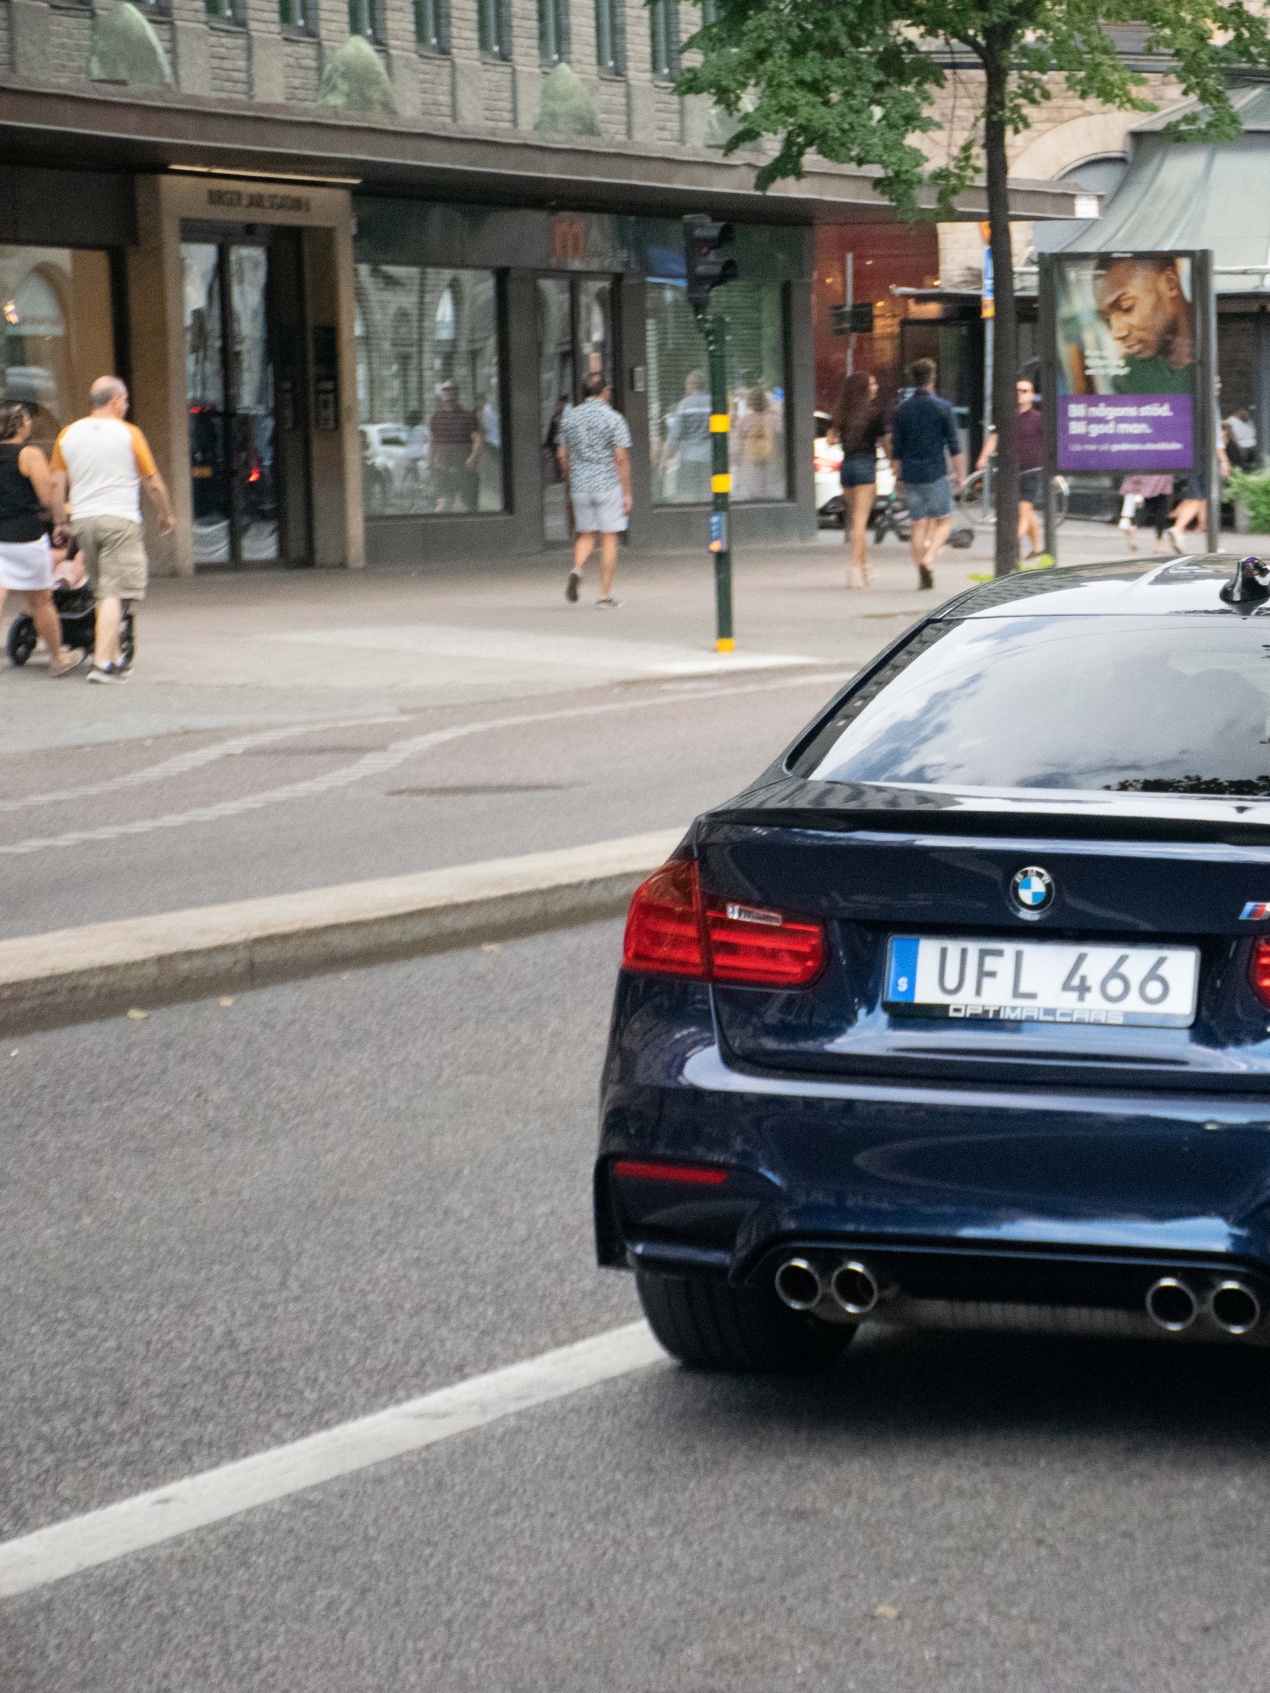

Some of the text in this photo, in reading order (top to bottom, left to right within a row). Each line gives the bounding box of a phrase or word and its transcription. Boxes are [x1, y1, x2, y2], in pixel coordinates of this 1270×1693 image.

[1068, 404, 1087, 417] Bli
[1088, 402, 1138, 419] någons
[1068, 420, 1154, 437] Bli god man.
[1015, 869, 1051, 885] BMW
[938, 946, 1170, 1005] UFL 466
[896, 976, 909, 993] S
[949, 1003, 1124, 1025] OPTIMALCARS
